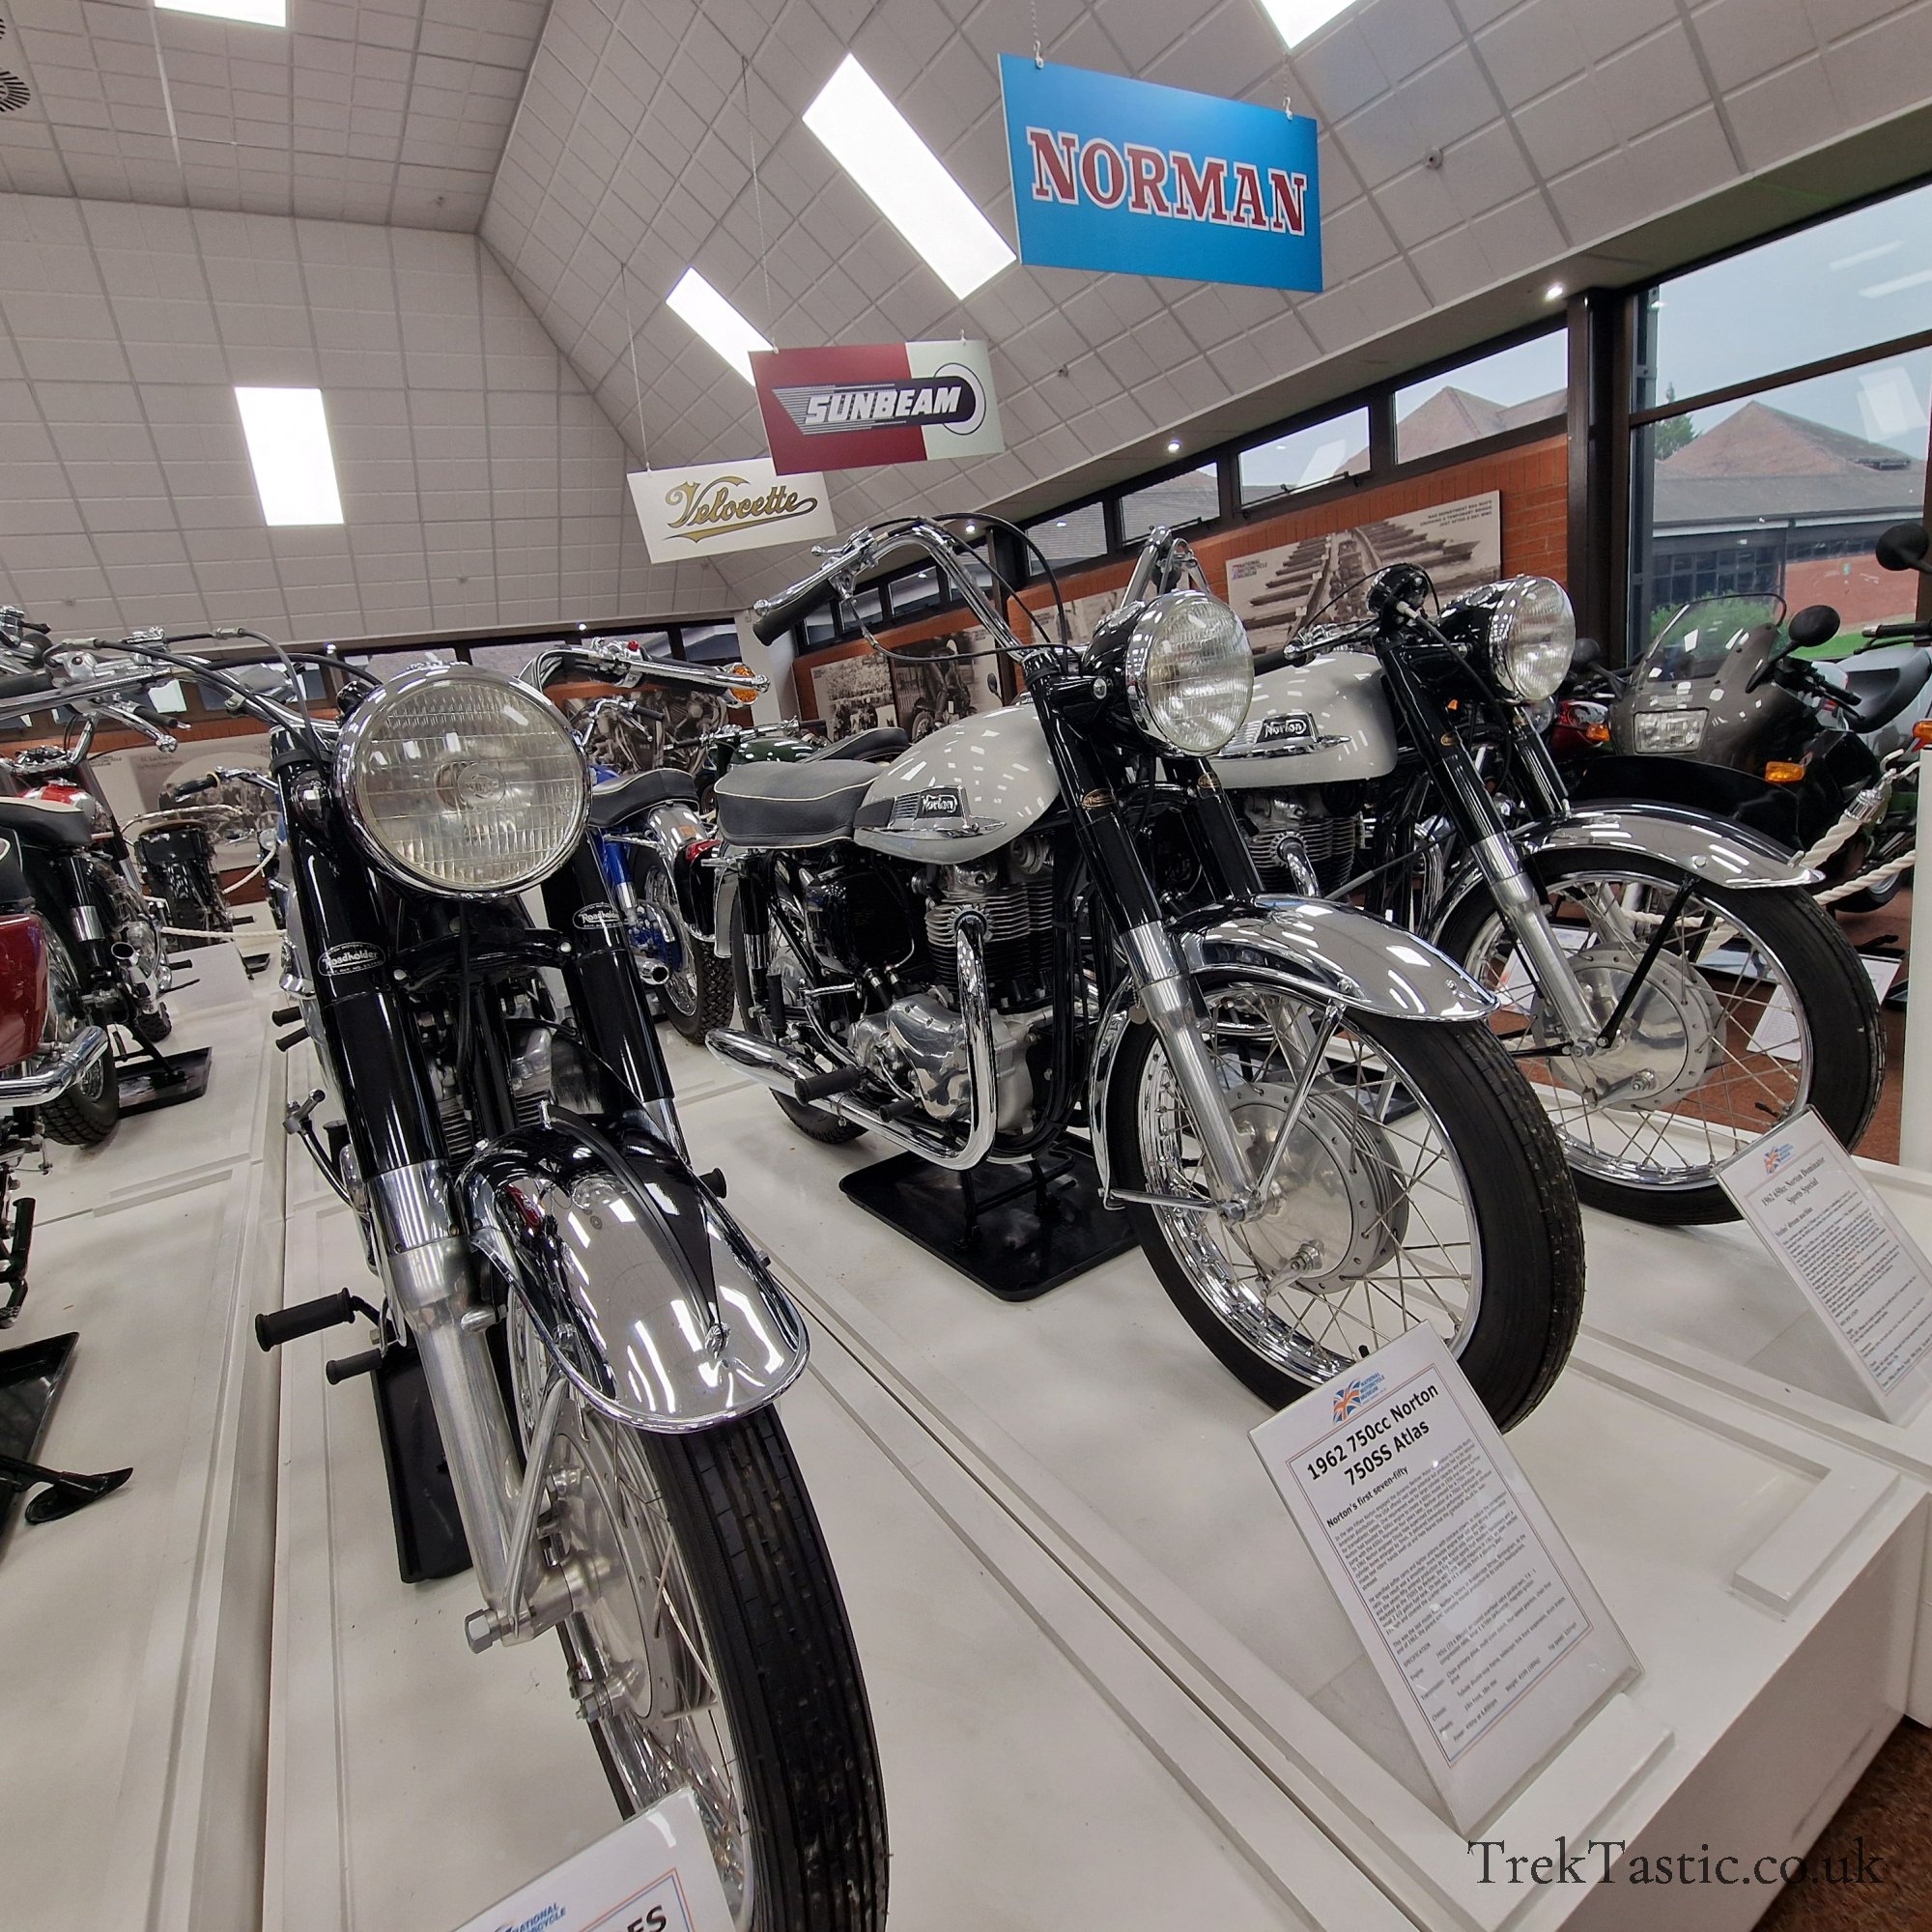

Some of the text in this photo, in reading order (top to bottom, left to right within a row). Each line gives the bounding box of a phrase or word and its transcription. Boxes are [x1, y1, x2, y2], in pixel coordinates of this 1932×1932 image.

[1026, 126, 1307, 236] NORMAN
[804, 386, 961, 425] SUNBEAM
[665, 475, 818, 528] Velocette
[1264, 719, 1307, 738] Norton
[921, 794, 958, 813] Norton
[1307, 1445, 1349, 1481] 1962
[1346, 1417, 1392, 1453] 750cc
[1389, 1385, 1439, 1423] Norton
[1344, 1421, 1430, 1486] 750SS Atlas
[1326, 1466, 1408, 1528] Norton's first seven-fifty
